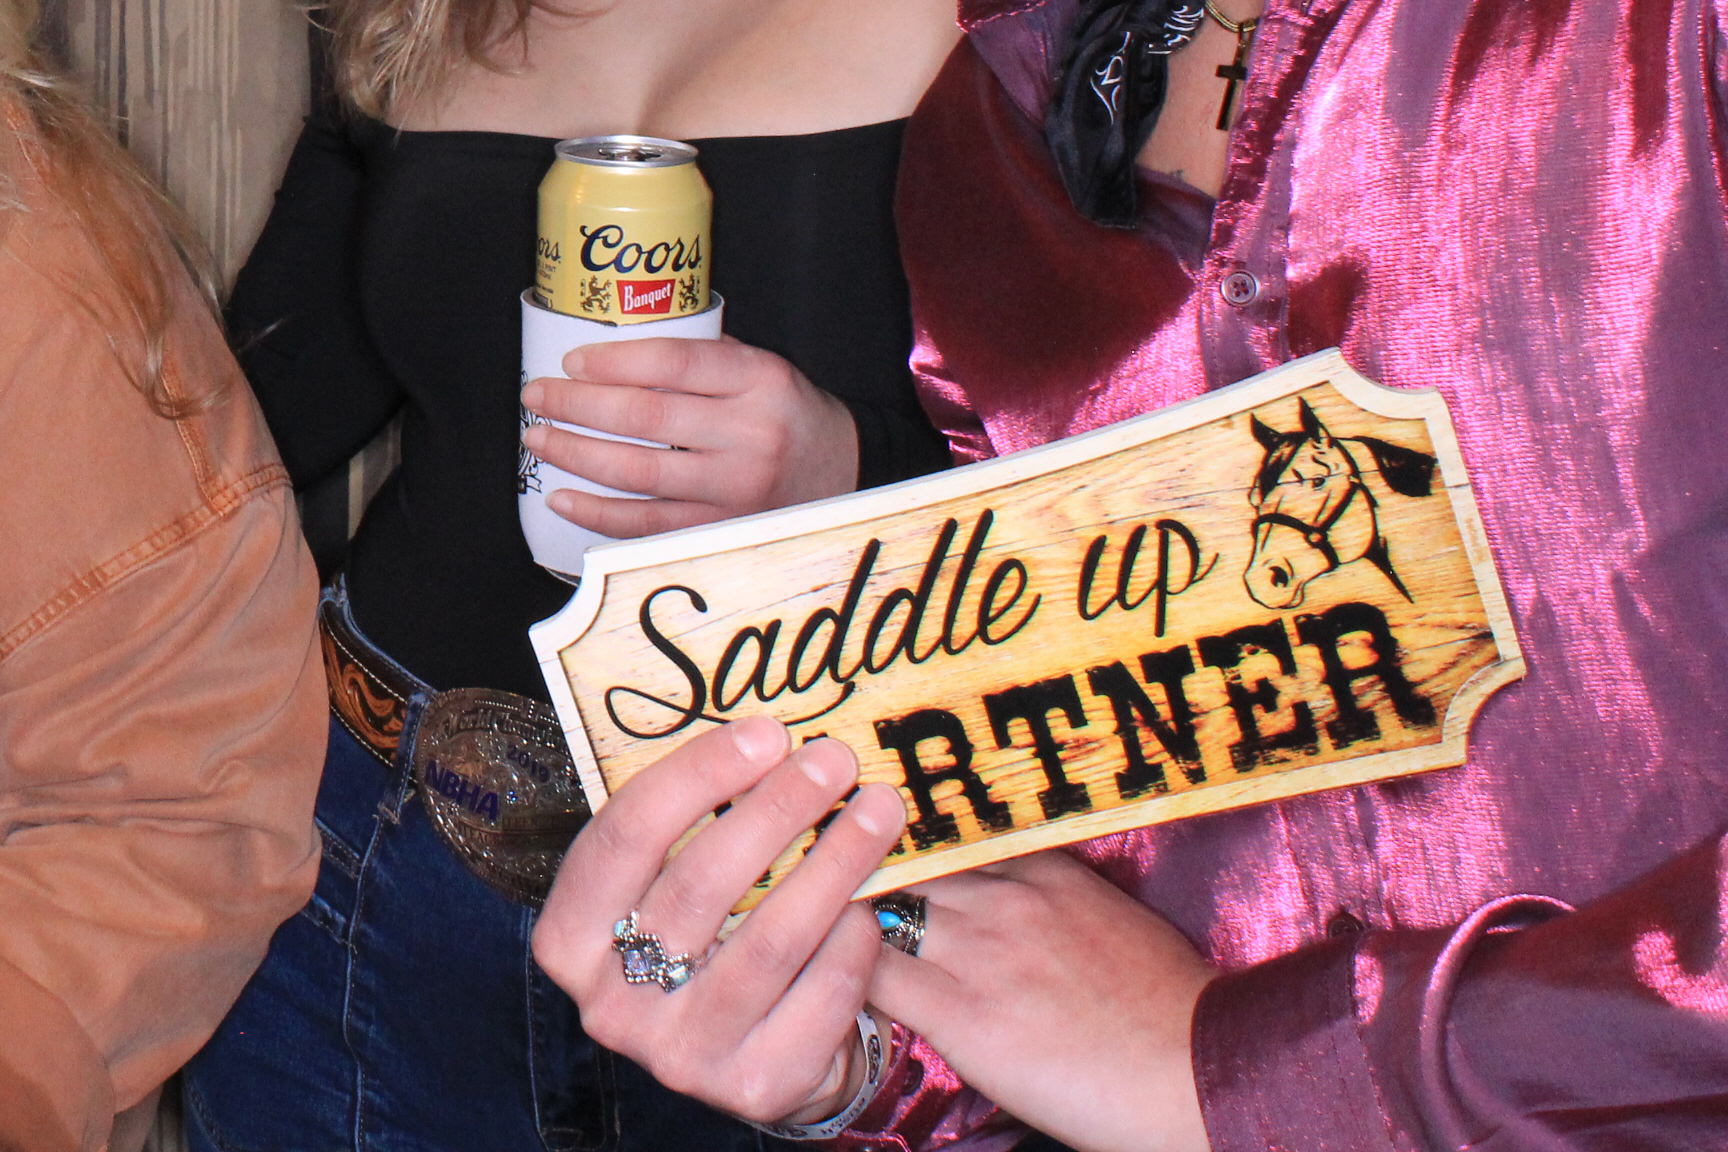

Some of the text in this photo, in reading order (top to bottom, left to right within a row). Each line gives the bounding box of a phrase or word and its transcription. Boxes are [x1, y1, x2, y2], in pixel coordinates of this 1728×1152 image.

[537, 237, 561, 262] ors
[579, 224, 702, 274] Coors
[623, 282, 671, 312] Banquet
[604, 509, 1221, 741] Saddle up
[506, 745, 550, 783] 2019
[715, 600, 1448, 890] RTNER
[423, 759, 501, 822] NBHA
